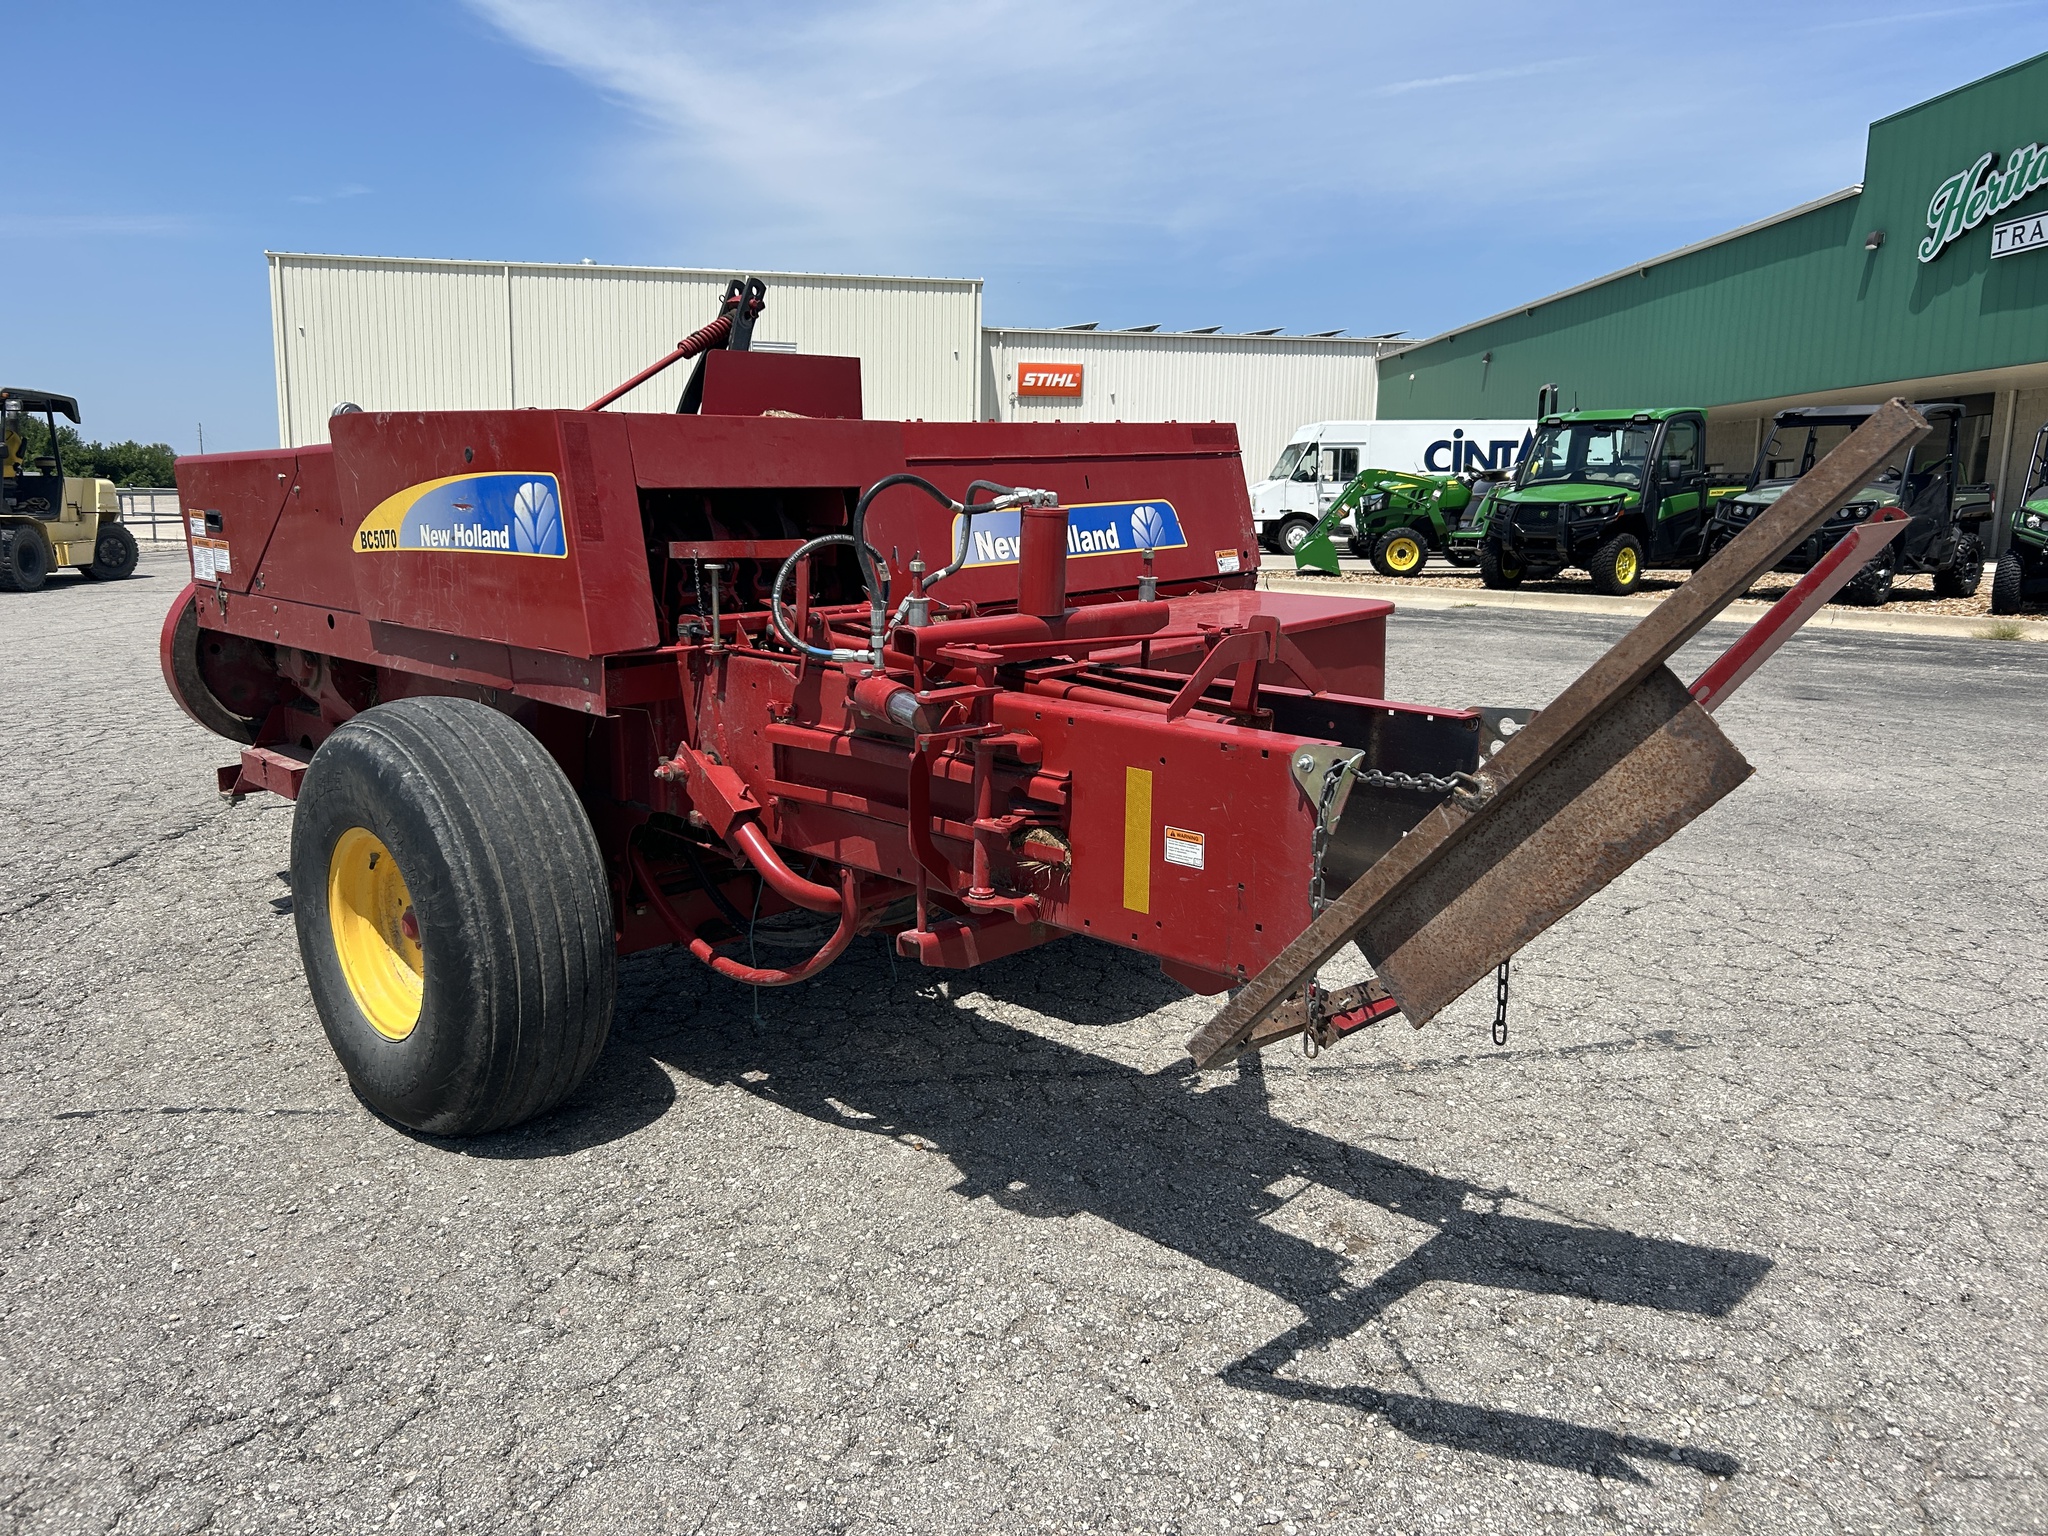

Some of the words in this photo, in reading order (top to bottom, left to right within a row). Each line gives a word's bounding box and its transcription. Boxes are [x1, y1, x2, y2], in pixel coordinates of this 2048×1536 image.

[1022, 372, 1078, 388] STIHL
[360, 529, 397, 549] BC5070
[419, 523, 450, 547] New
[453, 523, 510, 549] Holland
